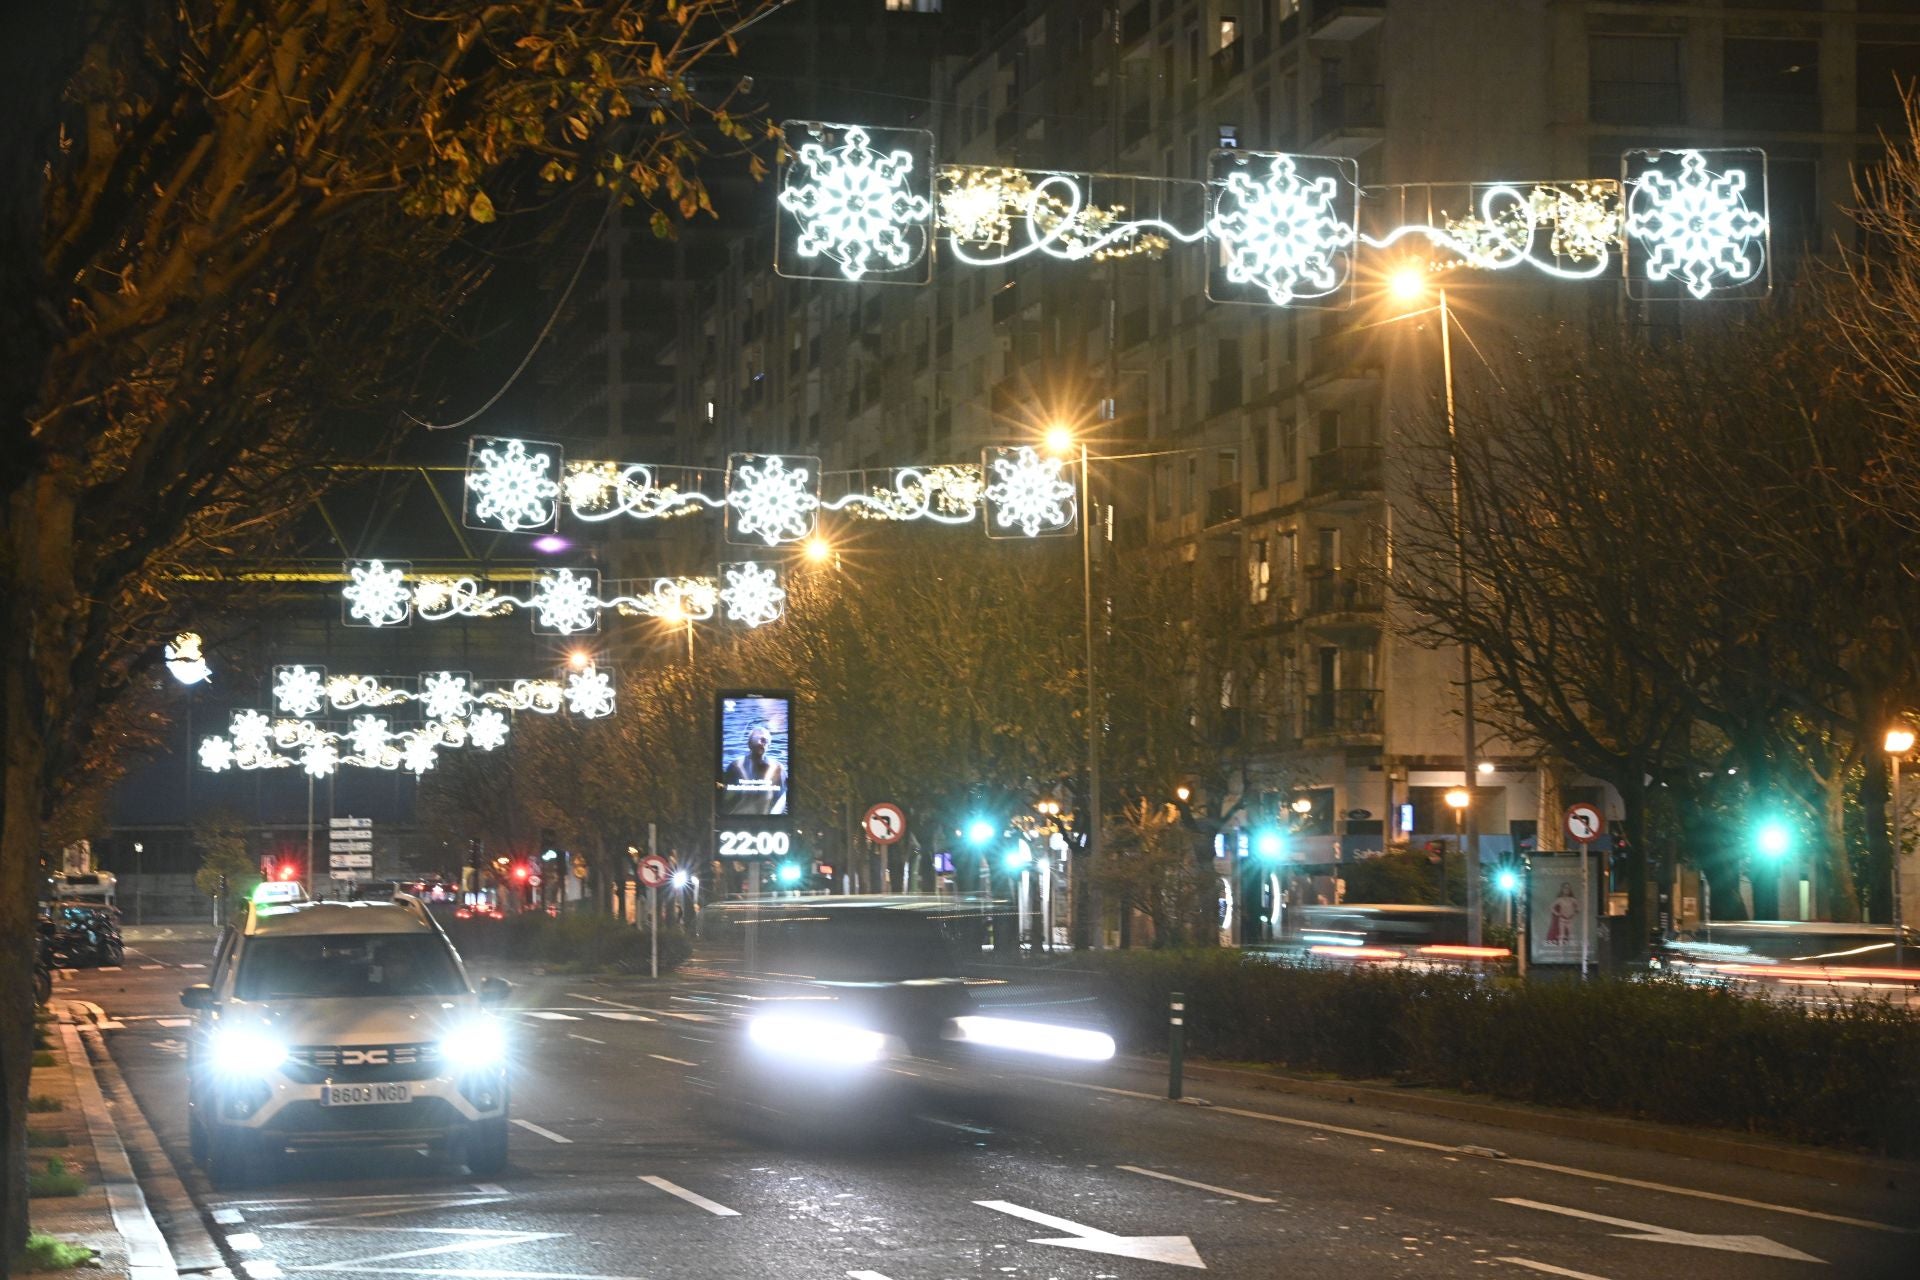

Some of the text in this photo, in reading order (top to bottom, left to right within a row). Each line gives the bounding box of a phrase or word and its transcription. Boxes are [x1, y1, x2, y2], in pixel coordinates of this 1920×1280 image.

[719, 831, 790, 856] 22:00
[331, 1085, 408, 1103] 8603 NGD
